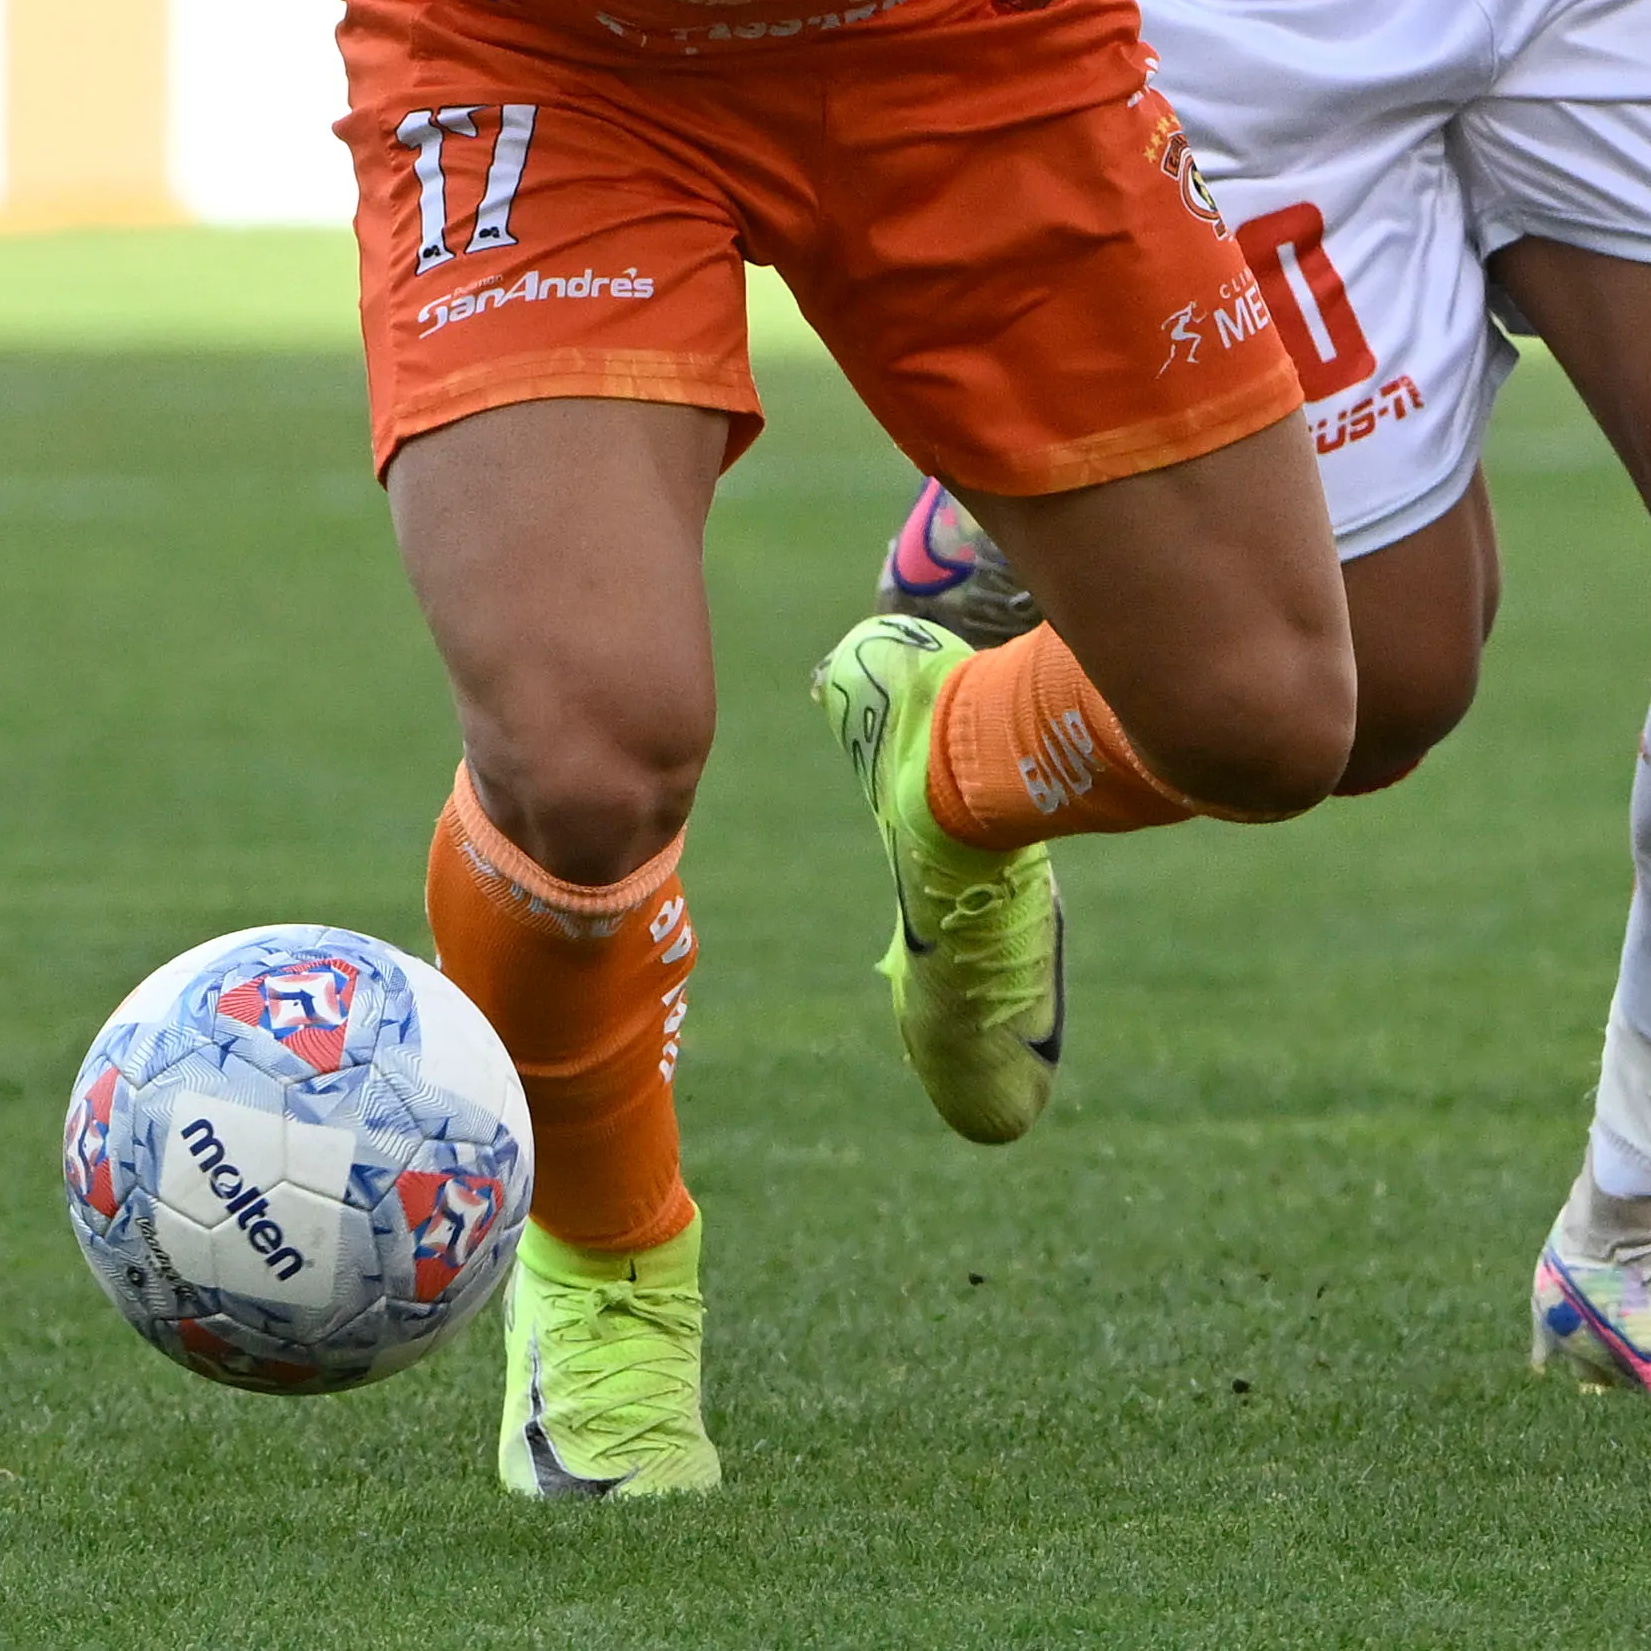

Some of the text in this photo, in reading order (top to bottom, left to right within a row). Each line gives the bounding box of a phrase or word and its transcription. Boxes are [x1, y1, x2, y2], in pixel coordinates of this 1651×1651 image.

[395, 103, 540, 277] 17
[1212, 282, 1272, 350] ME
[180, 1117, 305, 1282] molten
